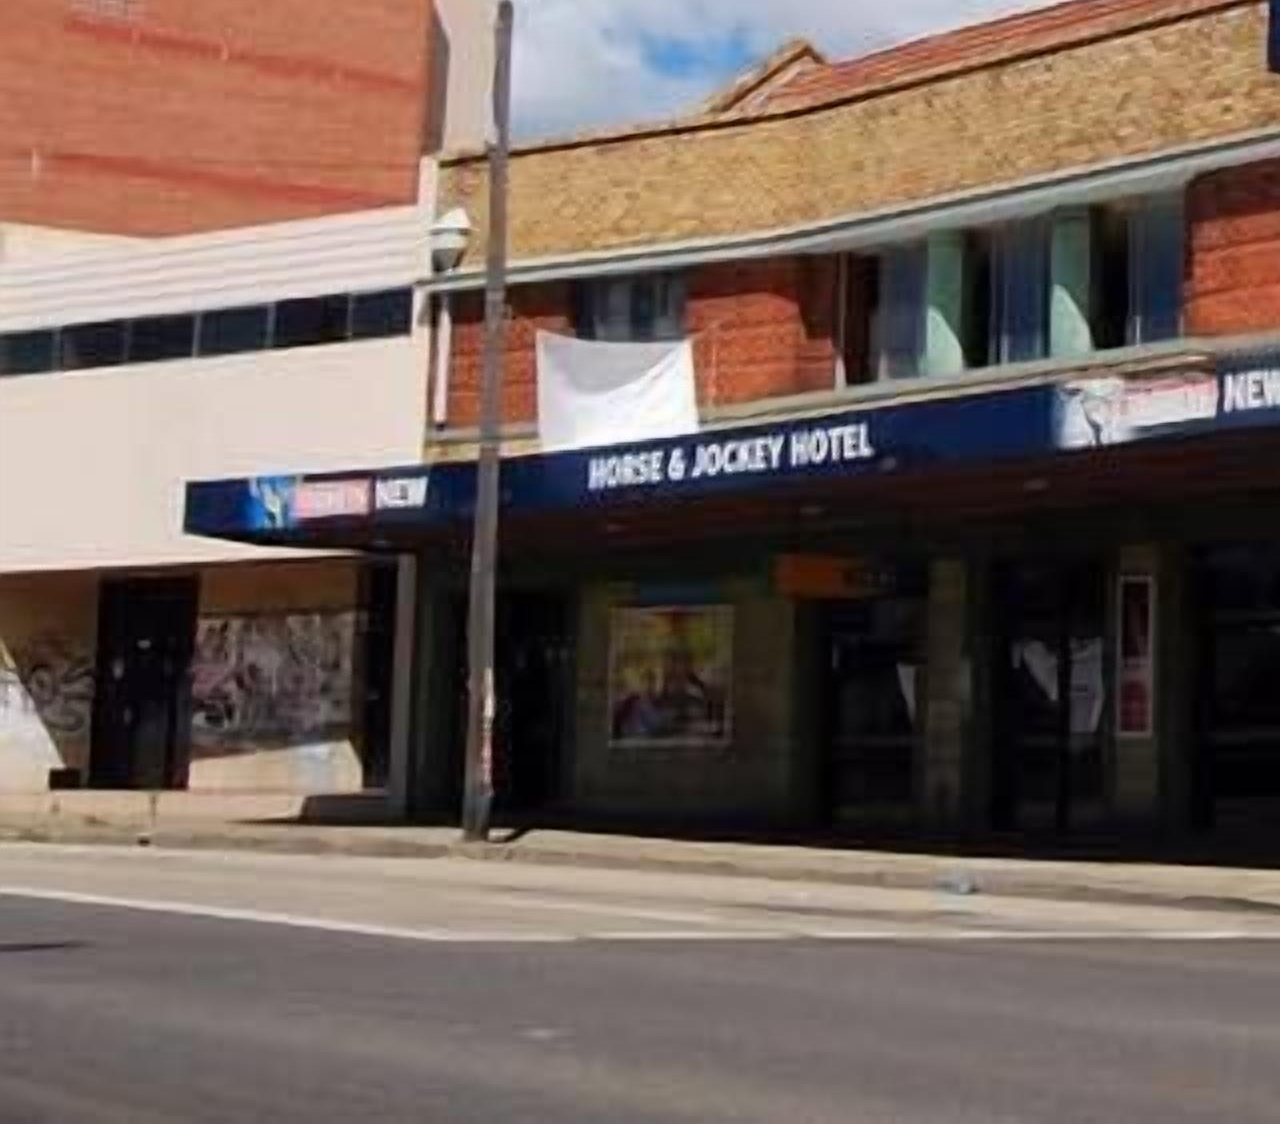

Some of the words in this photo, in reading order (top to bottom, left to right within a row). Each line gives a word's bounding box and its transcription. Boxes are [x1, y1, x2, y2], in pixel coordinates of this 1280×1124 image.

[588, 450, 664, 490] HORSE
[667, 447, 685, 481] &
[690, 432, 786, 478] JOCKEY
[790, 421, 875, 467] HOTEL
[375, 476, 429, 509] NEW
